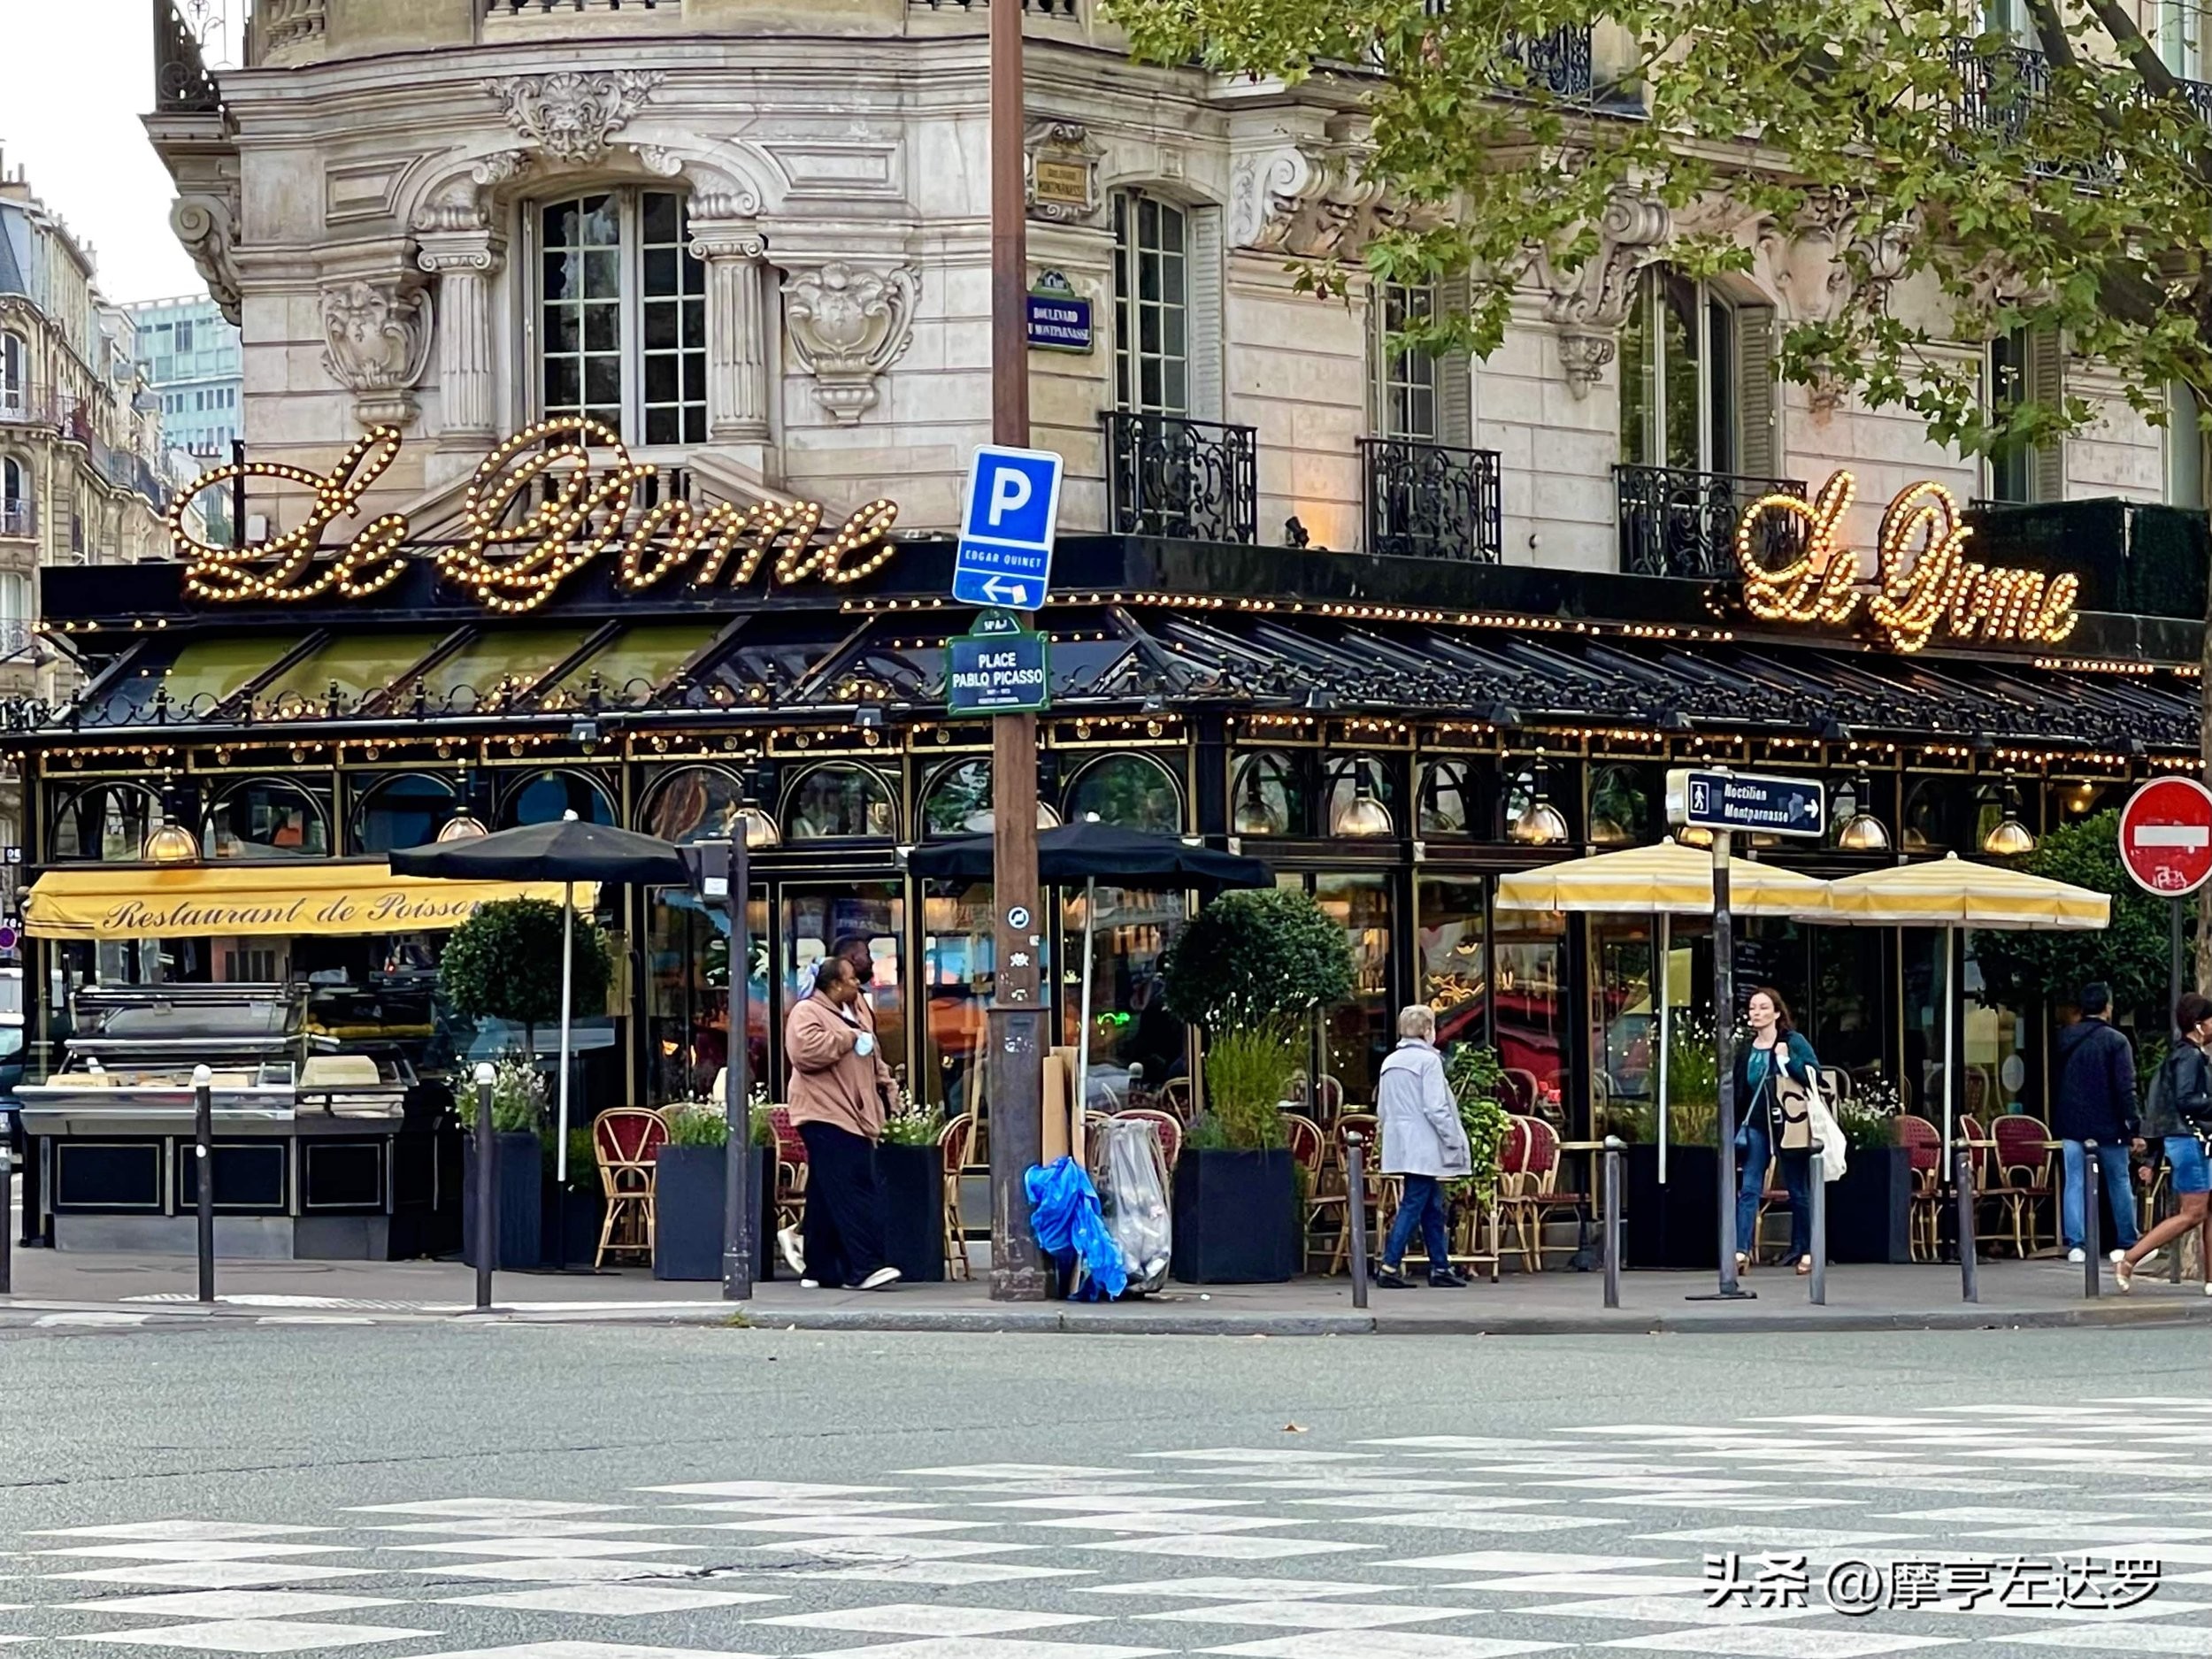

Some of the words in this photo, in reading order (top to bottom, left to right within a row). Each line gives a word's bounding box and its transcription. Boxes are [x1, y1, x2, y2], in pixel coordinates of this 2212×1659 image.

[1033, 307, 1079, 323] BOULEVARD
[1034, 324, 1089, 341] MONTPARNASSE
[988, 467, 1033, 526] P
[170, 424, 410, 602] Le
[1735, 469, 1862, 622] Le
[964, 549, 1000, 564] EDGAR
[1003, 555, 1042, 568] QUINET
[979, 652, 1017, 669] PLACE
[952, 672, 989, 688] PABLO
[993, 668, 1043, 686] PICASSO
[1724, 783, 1767, 801] Noctilien
[1724, 803, 1789, 823] Montparnasse
[103, 898, 307, 929] Restaurant
[316, 895, 355, 922] de
